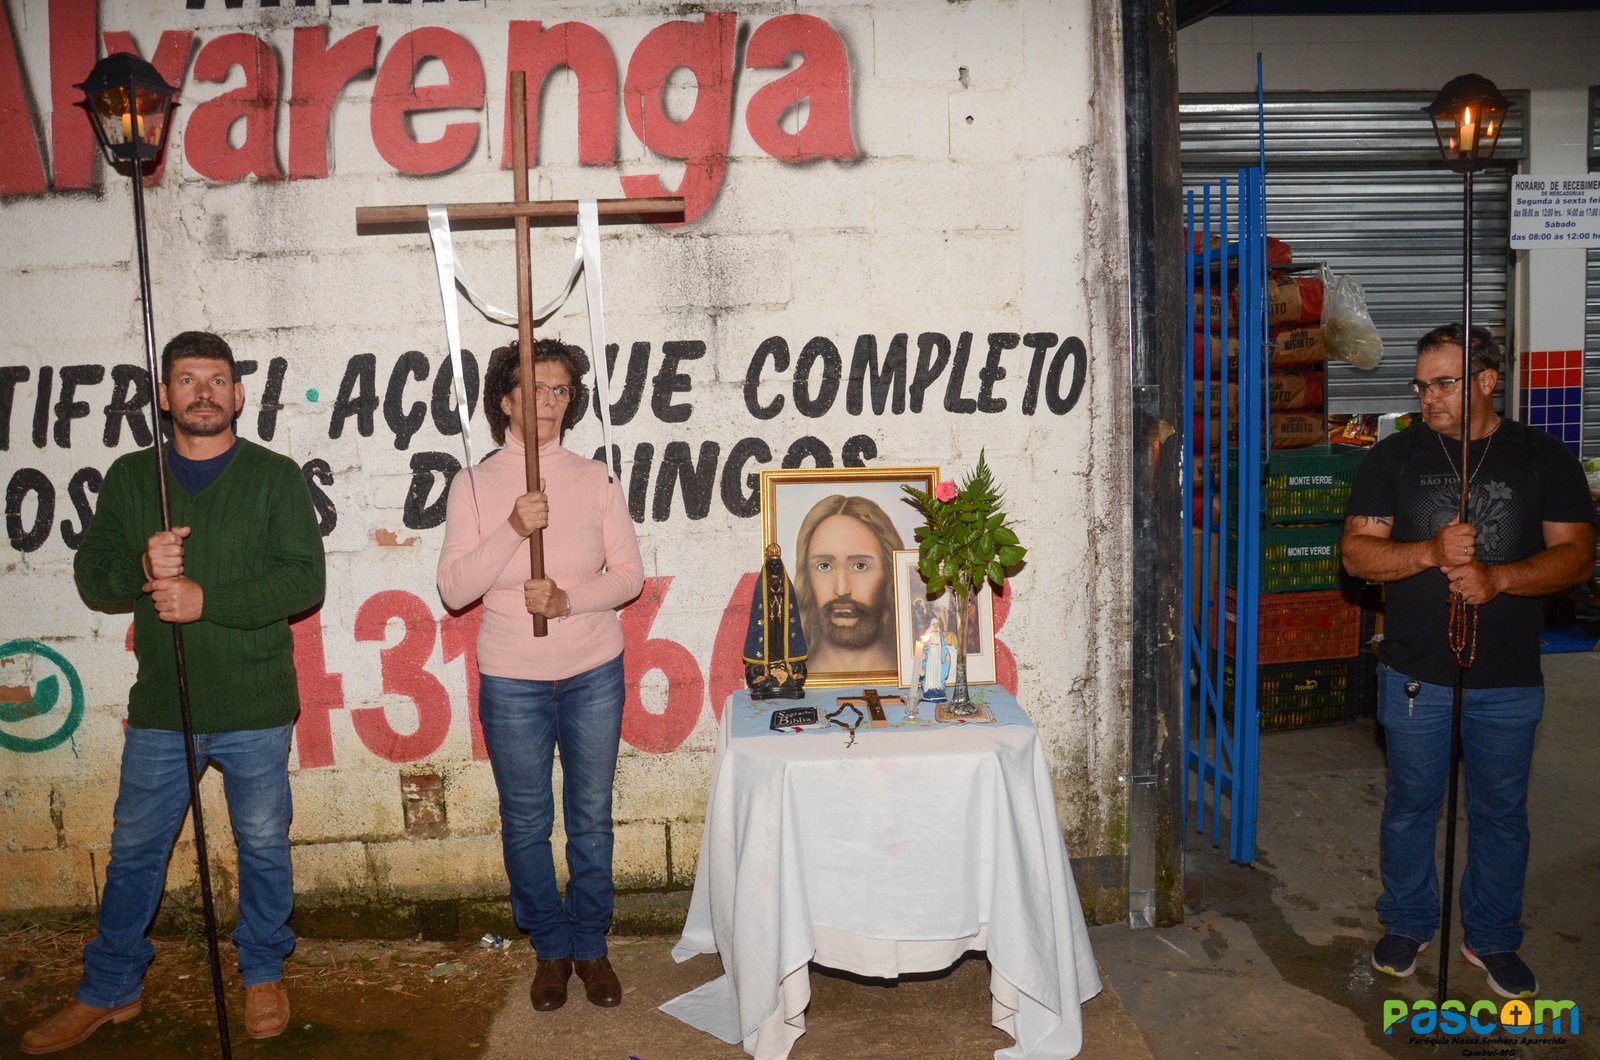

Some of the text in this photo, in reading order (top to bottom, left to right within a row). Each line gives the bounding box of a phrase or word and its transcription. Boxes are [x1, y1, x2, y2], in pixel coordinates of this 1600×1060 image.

[1550, 181, 1559, 190] DE
[1516, 198, 1552, 206] Segunda
[1566, 232, 1590, 240] 12:00
[328, 340, 706, 450] AÇOUE
[743, 332, 1088, 419] COMPLETO
[1281, 423, 1313, 432] NEGRITO
[1289, 475, 1333, 485] MONTE VERDE
[1287, 546, 1331, 557] MONTE VERDE
